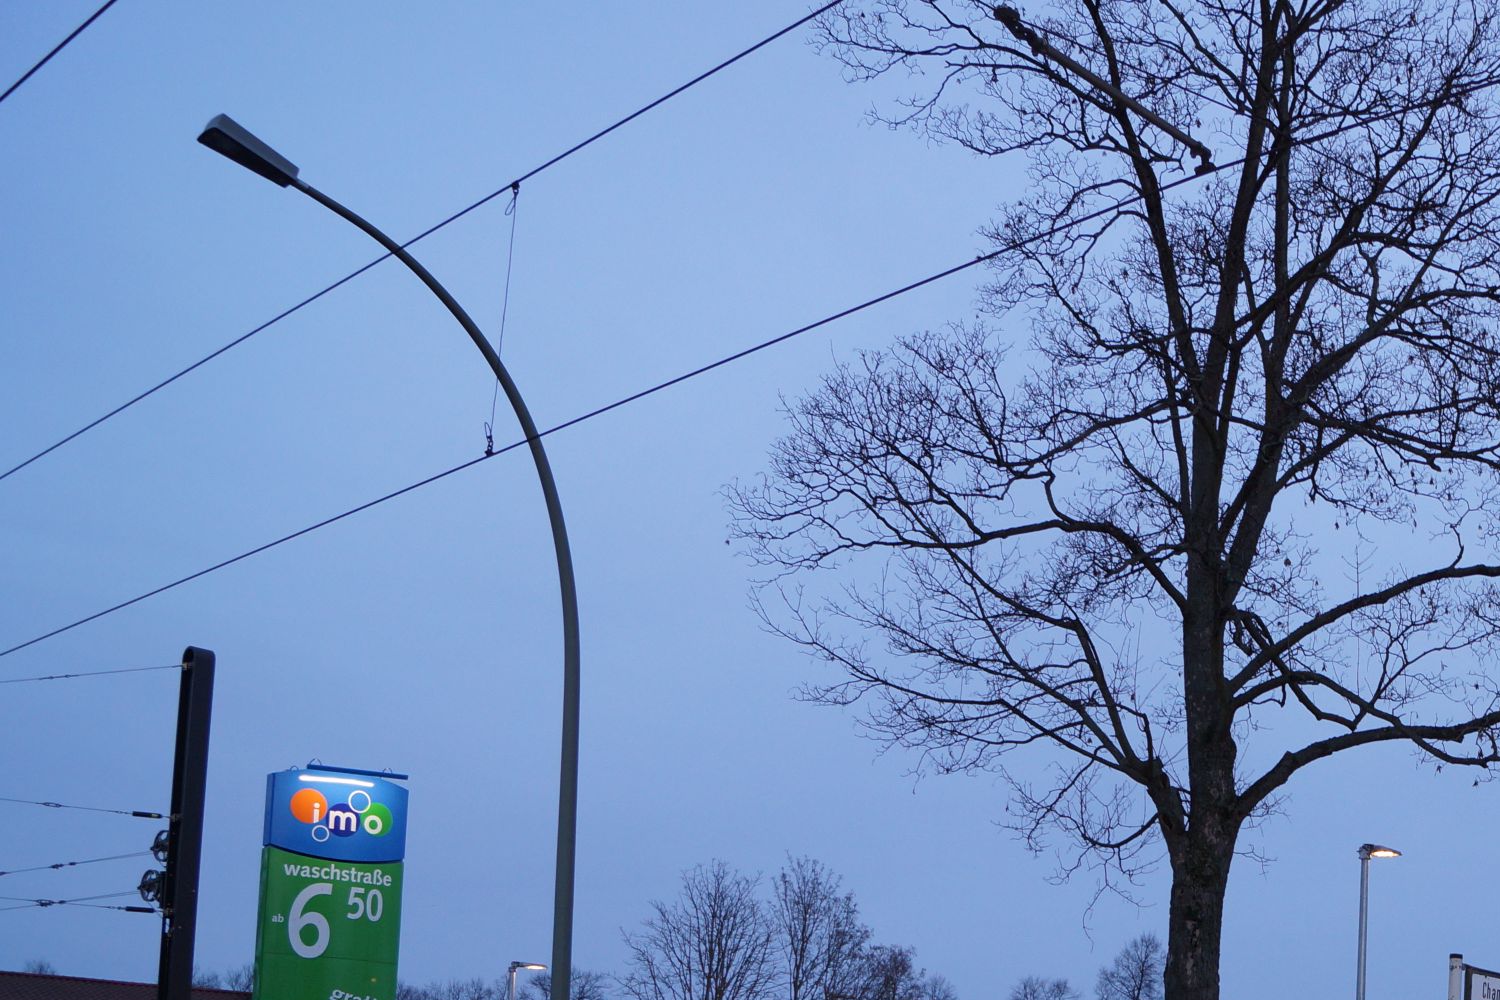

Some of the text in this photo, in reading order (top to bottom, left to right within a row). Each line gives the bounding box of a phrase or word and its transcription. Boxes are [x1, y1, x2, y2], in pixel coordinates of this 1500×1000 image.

[312, 802, 383, 835] imo
[283, 863, 392, 887] waschstraße
[271, 882, 383, 959] ab 6 50
